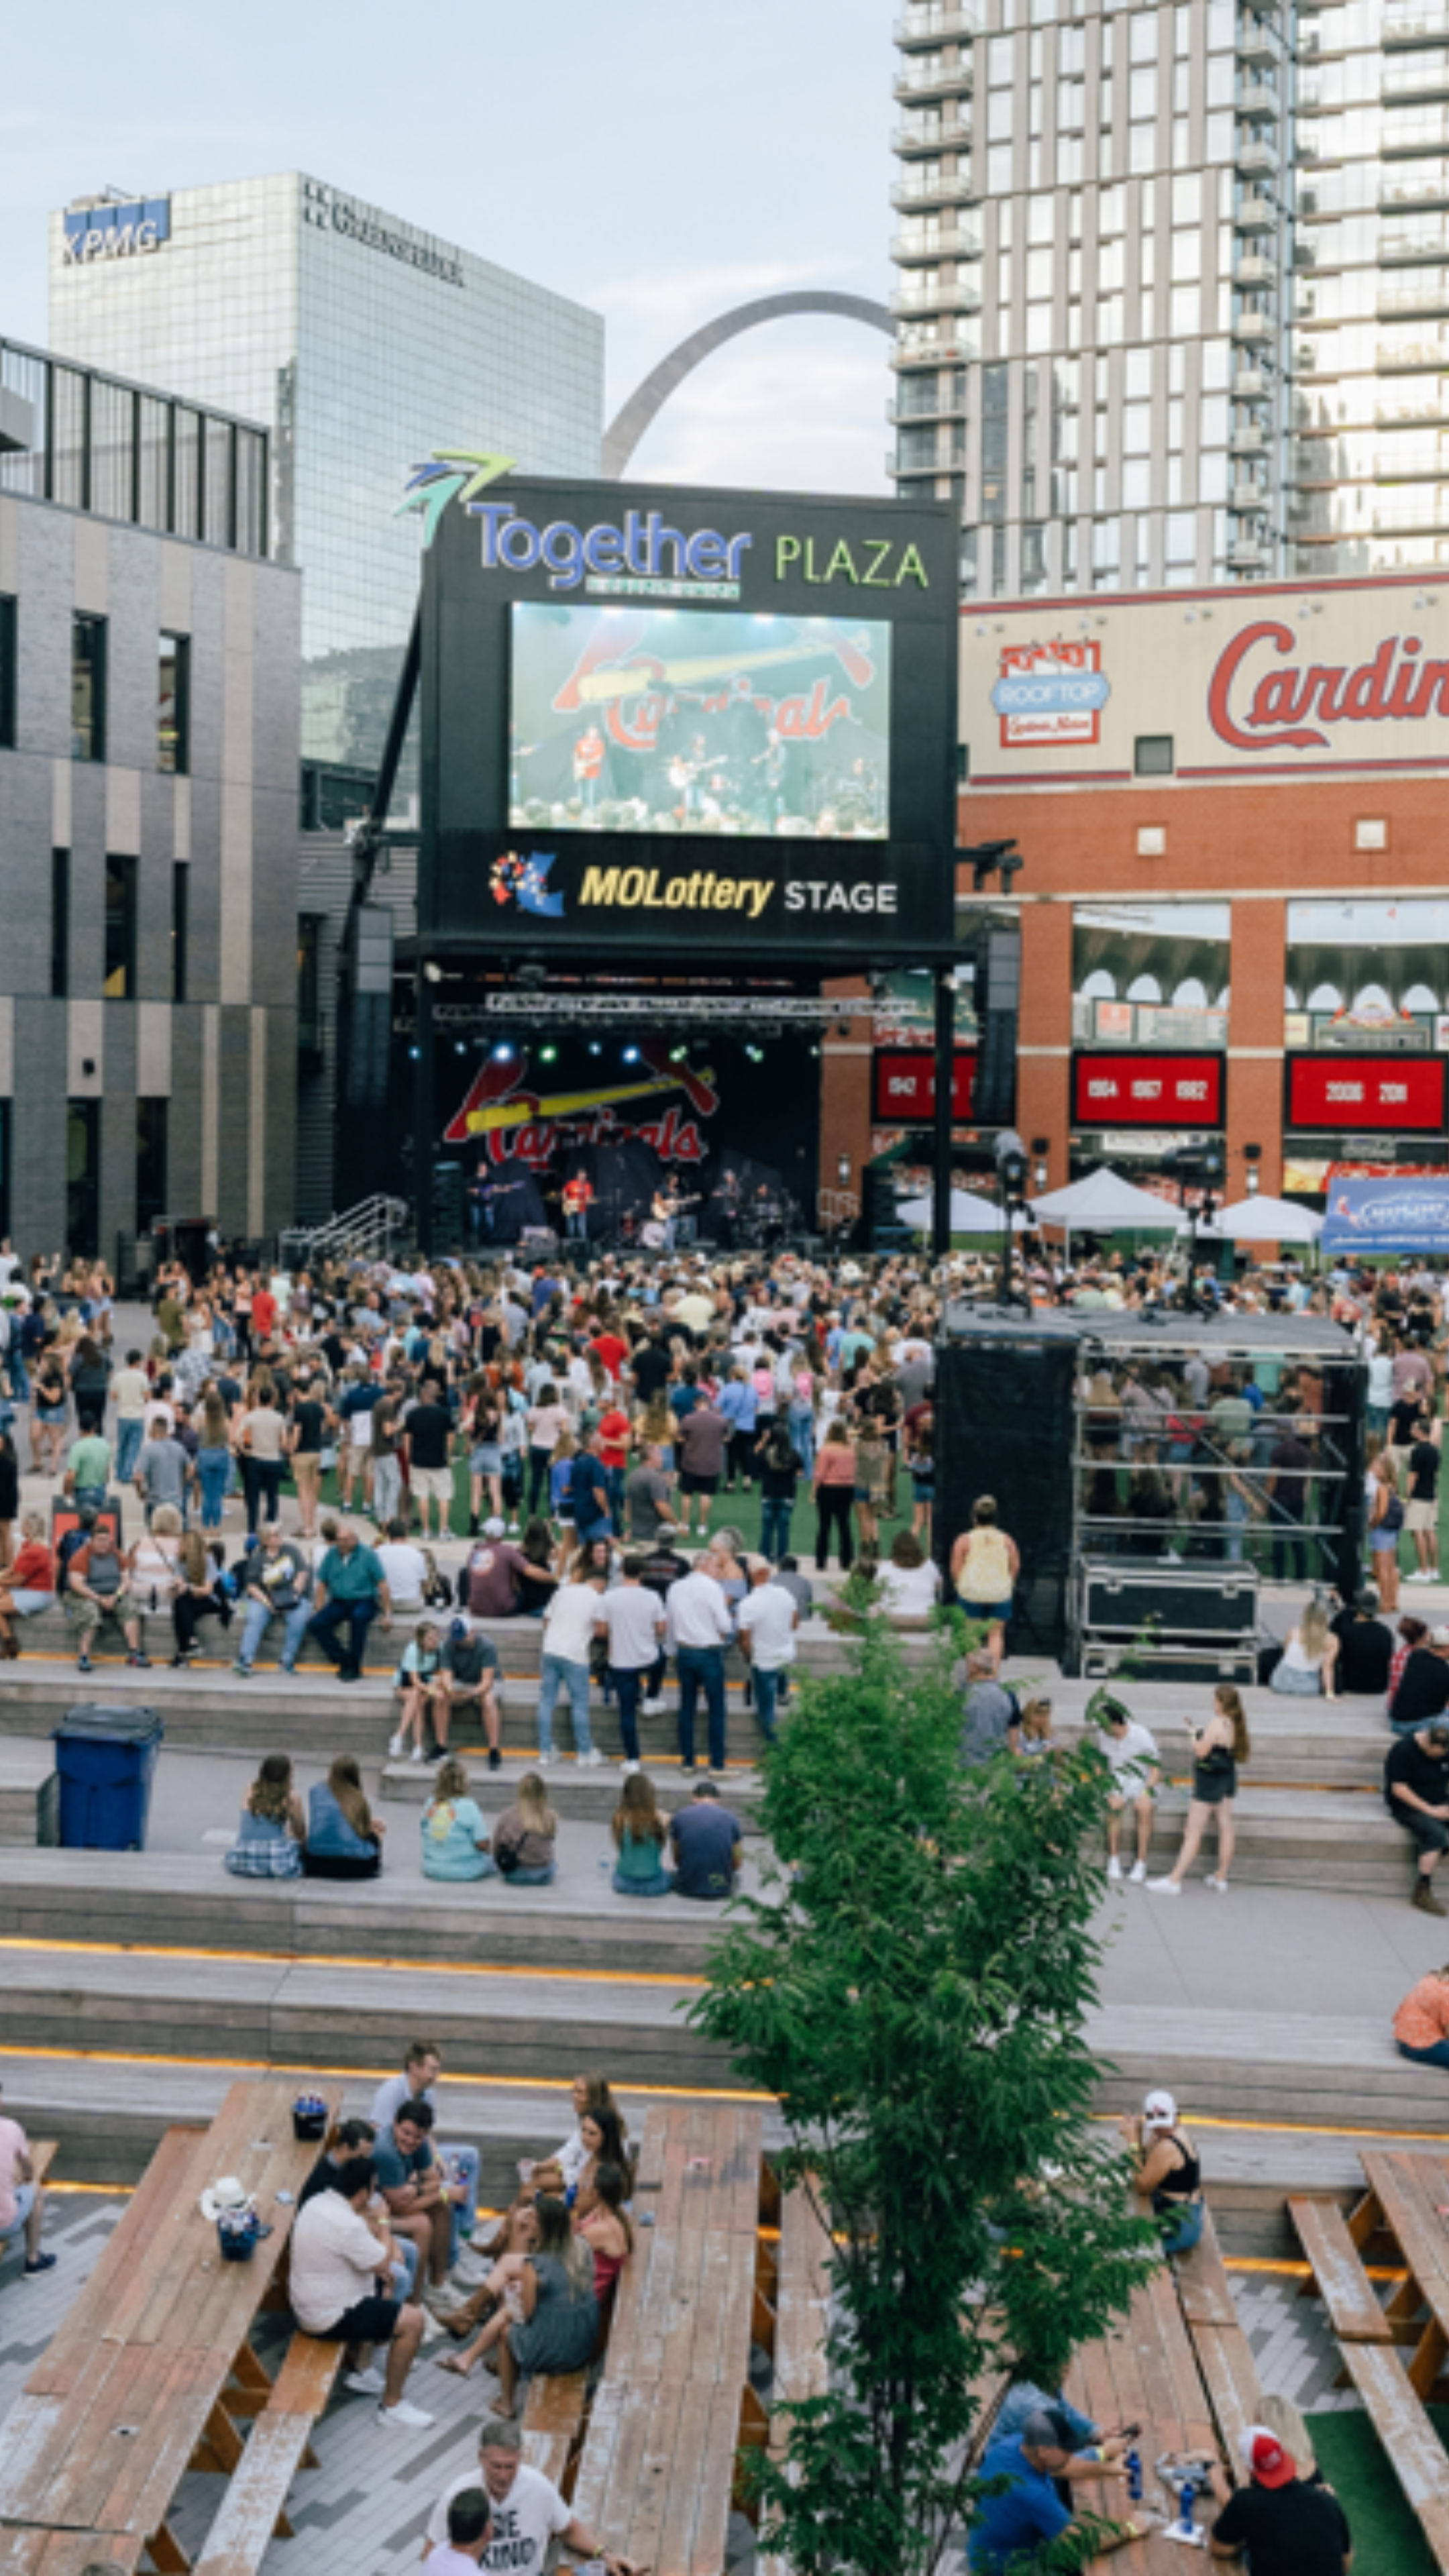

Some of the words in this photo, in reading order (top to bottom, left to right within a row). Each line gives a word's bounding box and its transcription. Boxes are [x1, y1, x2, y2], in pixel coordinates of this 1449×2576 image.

[62, 218, 159, 266] KPMG
[466, 502, 752, 590] Together
[775, 535, 929, 589] PLAZA
[1000, 681, 1102, 705] ROOFTOP
[579, 865, 775, 918] MOLottery
[784, 880, 898, 913] STAGE
[477, 2536, 537, 2571] KIND
